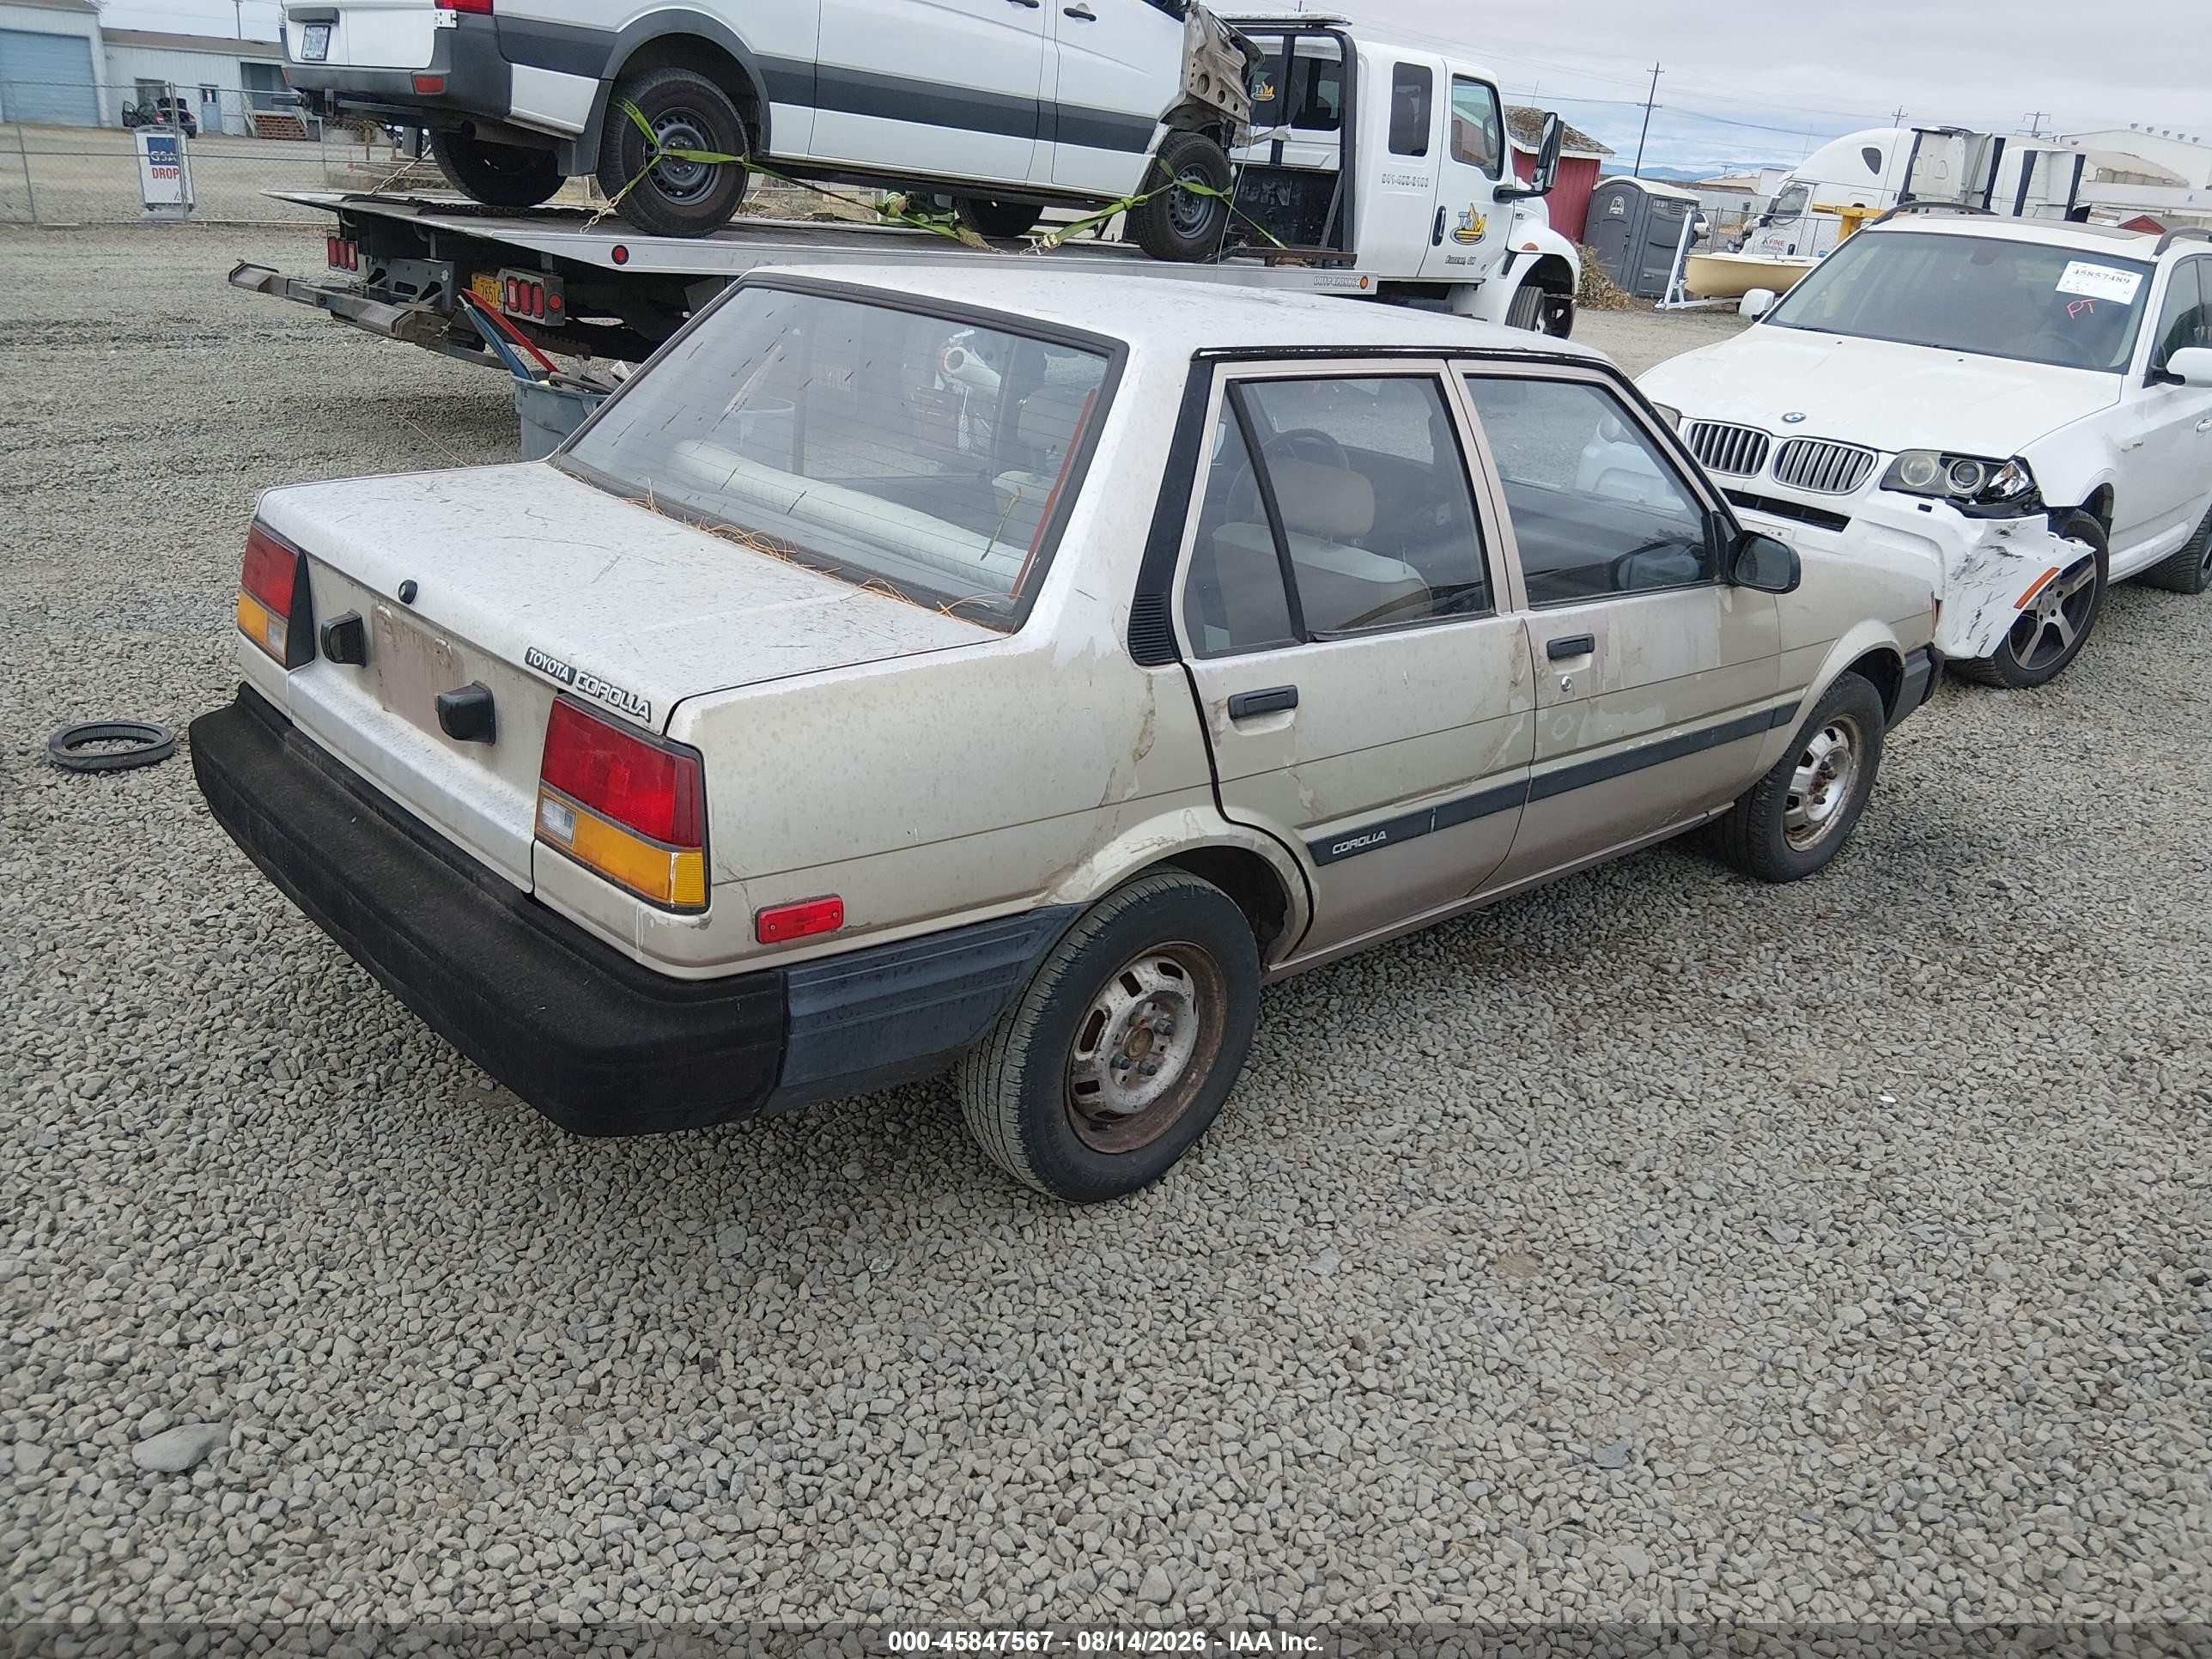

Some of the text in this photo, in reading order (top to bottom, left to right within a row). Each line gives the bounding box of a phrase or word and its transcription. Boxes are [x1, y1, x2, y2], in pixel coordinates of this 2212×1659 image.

[151, 167, 179, 179] DROP
[2066, 298, 2099, 319] PT
[527, 648, 652, 723] TOYOTA COROLLA
[1332, 830, 1388, 854] COROLLA
